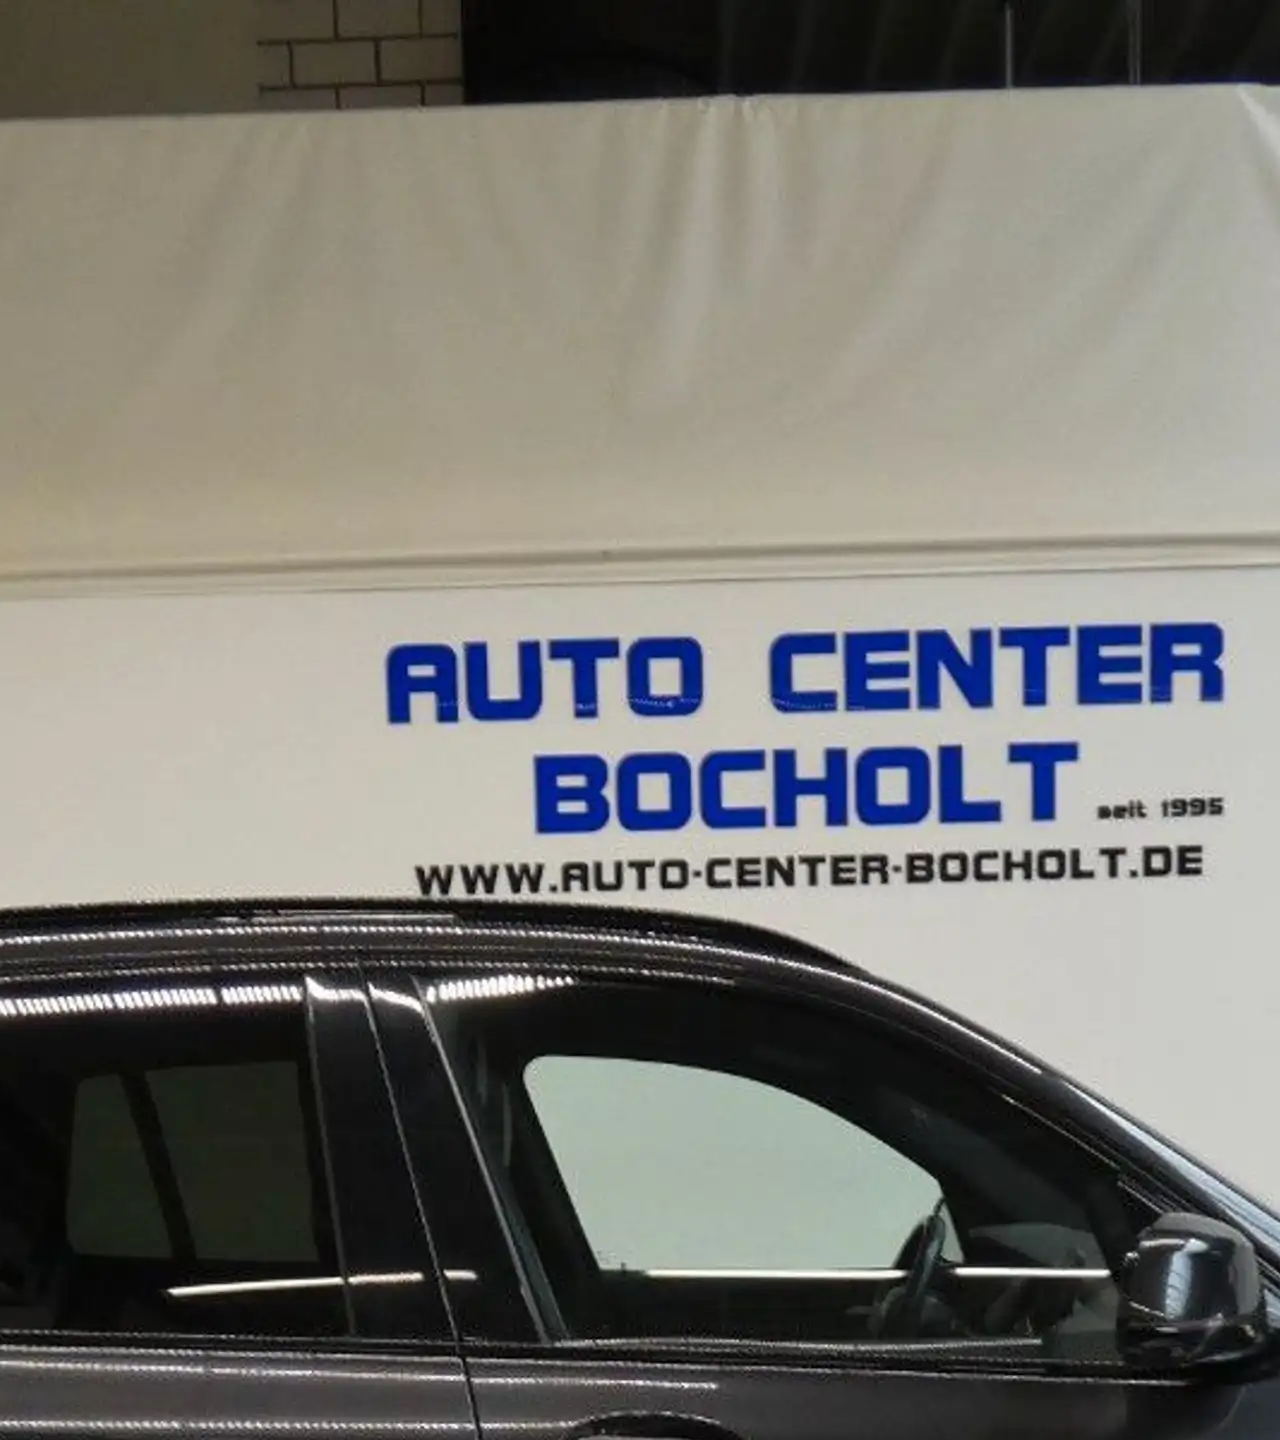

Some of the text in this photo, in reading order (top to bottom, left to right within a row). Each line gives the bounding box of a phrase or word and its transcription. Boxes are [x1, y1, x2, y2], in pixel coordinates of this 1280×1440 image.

[386, 621, 1226, 725] AUTO CENTER
[534, 741, 1226, 837] BOCHOLT seit 1995
[414, 843, 1205, 898] WWW.AUTO-CENTER-BOCHOLT.DE
